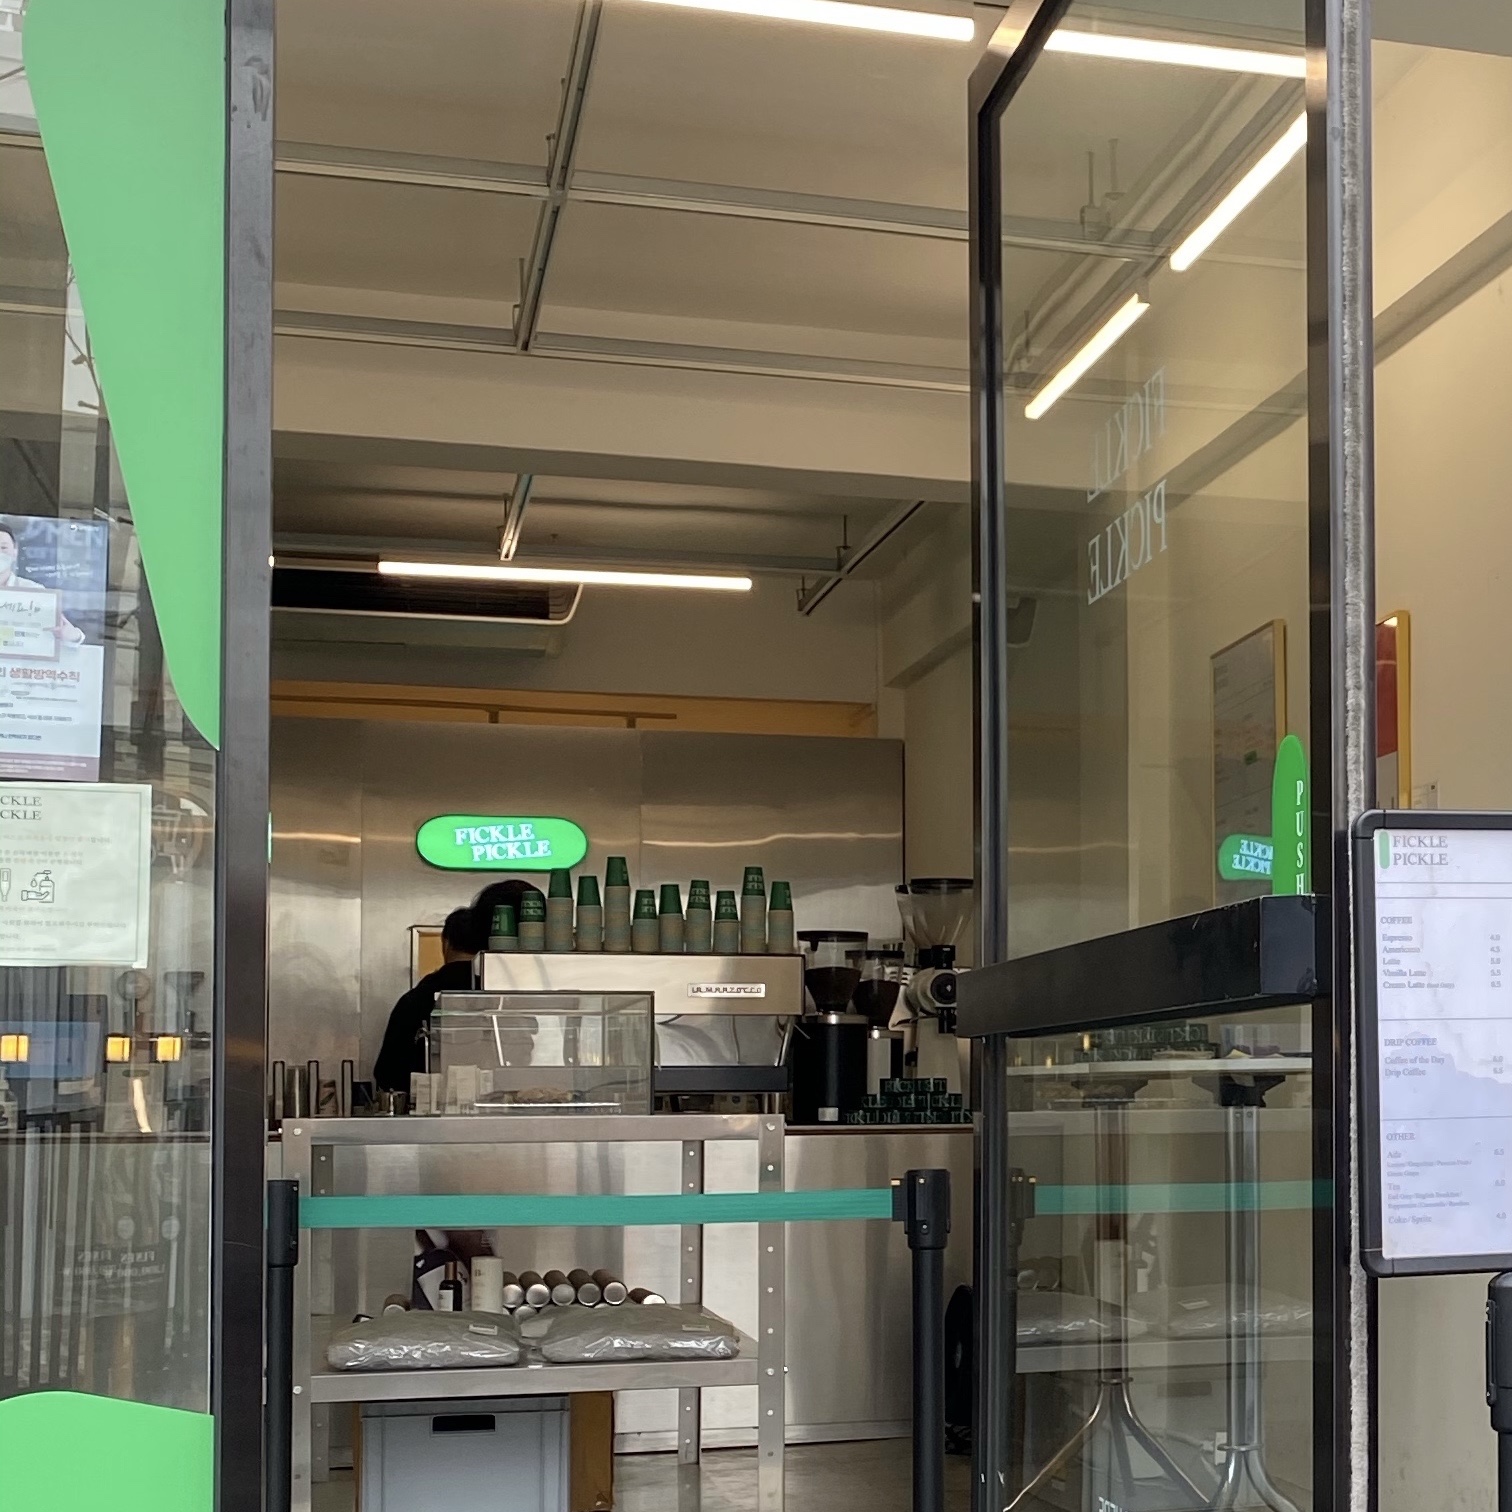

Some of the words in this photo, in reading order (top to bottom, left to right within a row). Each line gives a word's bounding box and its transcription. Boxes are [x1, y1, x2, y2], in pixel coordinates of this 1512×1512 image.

[454, 823, 535, 846] FICKLE
[1296, 780, 1305, 895] PUSH
[1392, 835, 1448, 848] FICKLE
[471, 839, 552, 863] PICKLE
[1393, 853, 1448, 866] PICKLE
[1380, 916, 1413, 925] COFFEE
[1405, 1038, 1437, 1046] COFFEE
